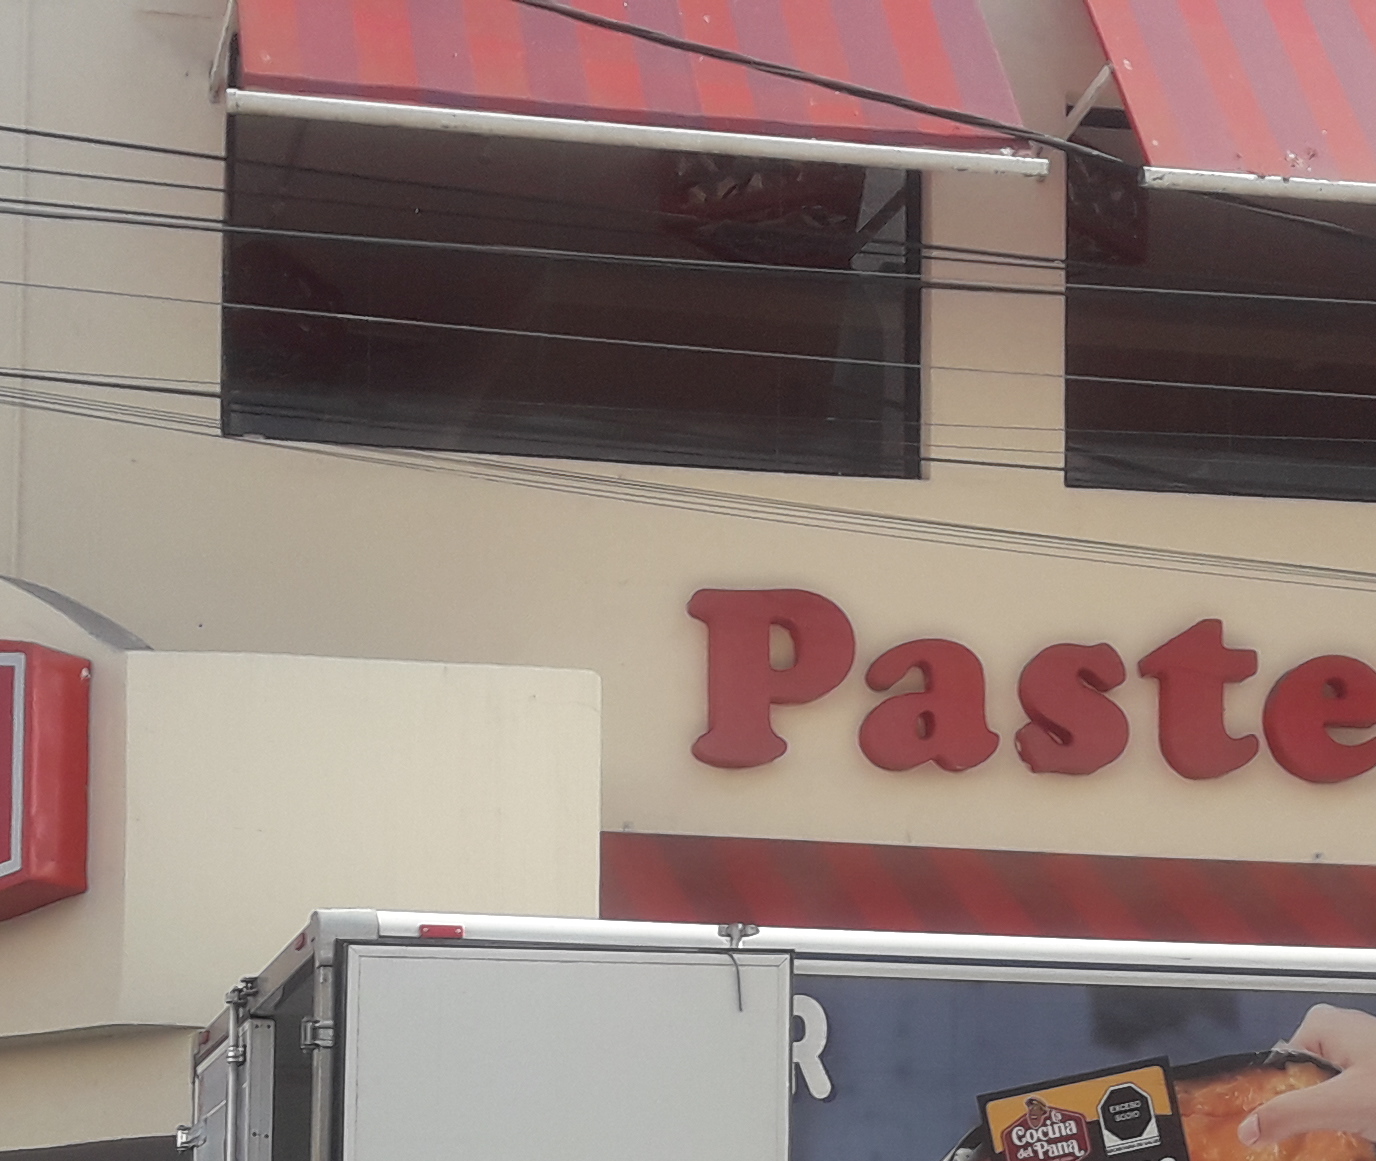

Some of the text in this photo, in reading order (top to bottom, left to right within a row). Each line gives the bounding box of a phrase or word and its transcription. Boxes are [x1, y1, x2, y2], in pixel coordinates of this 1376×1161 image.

[1011, 1118, 1078, 1146] Cocina
[1016, 1146, 1033, 1160] del
[1033, 1138, 1085, 1160] Pana
